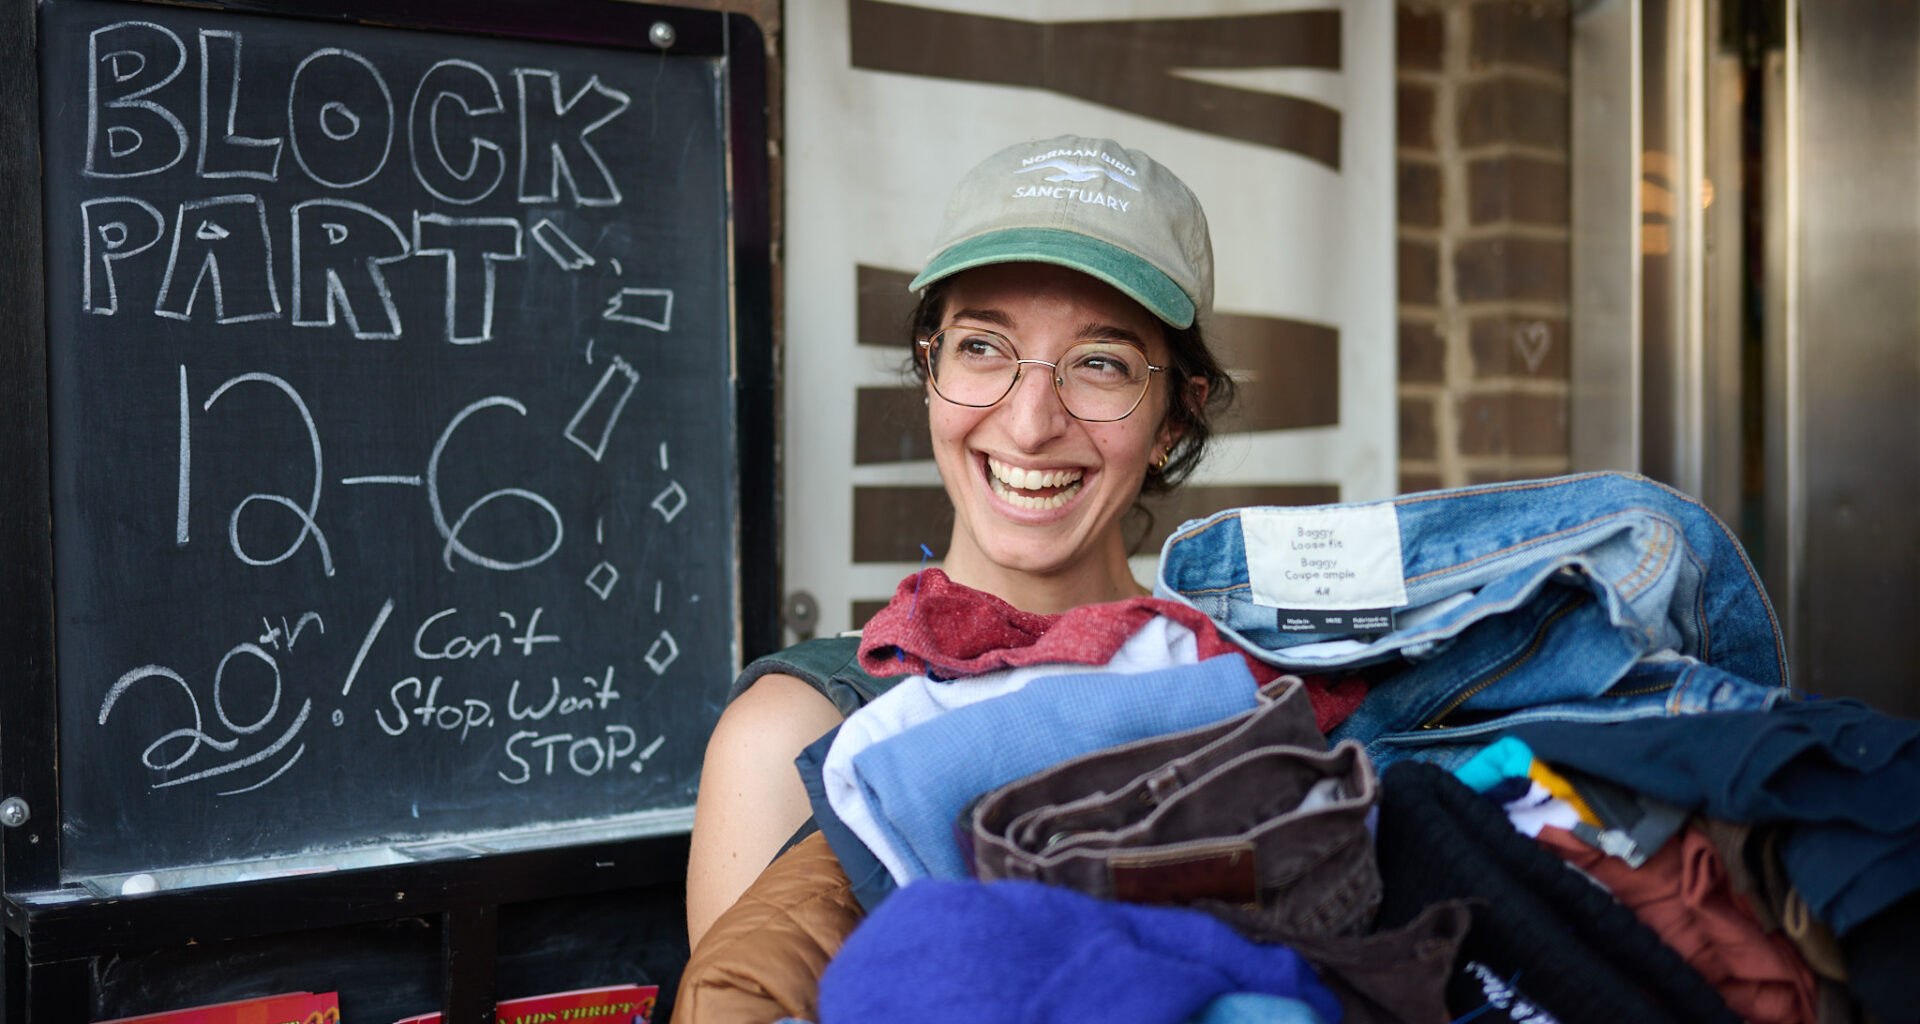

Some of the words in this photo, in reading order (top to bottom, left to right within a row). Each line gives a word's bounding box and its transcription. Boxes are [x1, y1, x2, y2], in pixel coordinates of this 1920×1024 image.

[82, 20, 631, 206] BLOCK
[1022, 149, 1098, 166] NORMAN
[1101, 152, 1137, 177] BIRD
[1012, 185, 1131, 212] SANCTUARY
[1291, 540, 1325, 551] Loose
[1328, 539, 1344, 549] fit
[1297, 526, 1335, 540] Baggy
[1284, 570, 1320, 582] Coupe
[1323, 569, 1356, 582] ample
[1301, 557, 1338, 570] Baggy
[414, 606, 561, 660] Can't
[375, 676, 495, 744] Stop.
[508, 666, 620, 720] Won't
[498, 725, 666, 785] STOP!
[515, 1010, 558, 1024] AIDS
[559, 1001, 636, 1021] THRIFT
